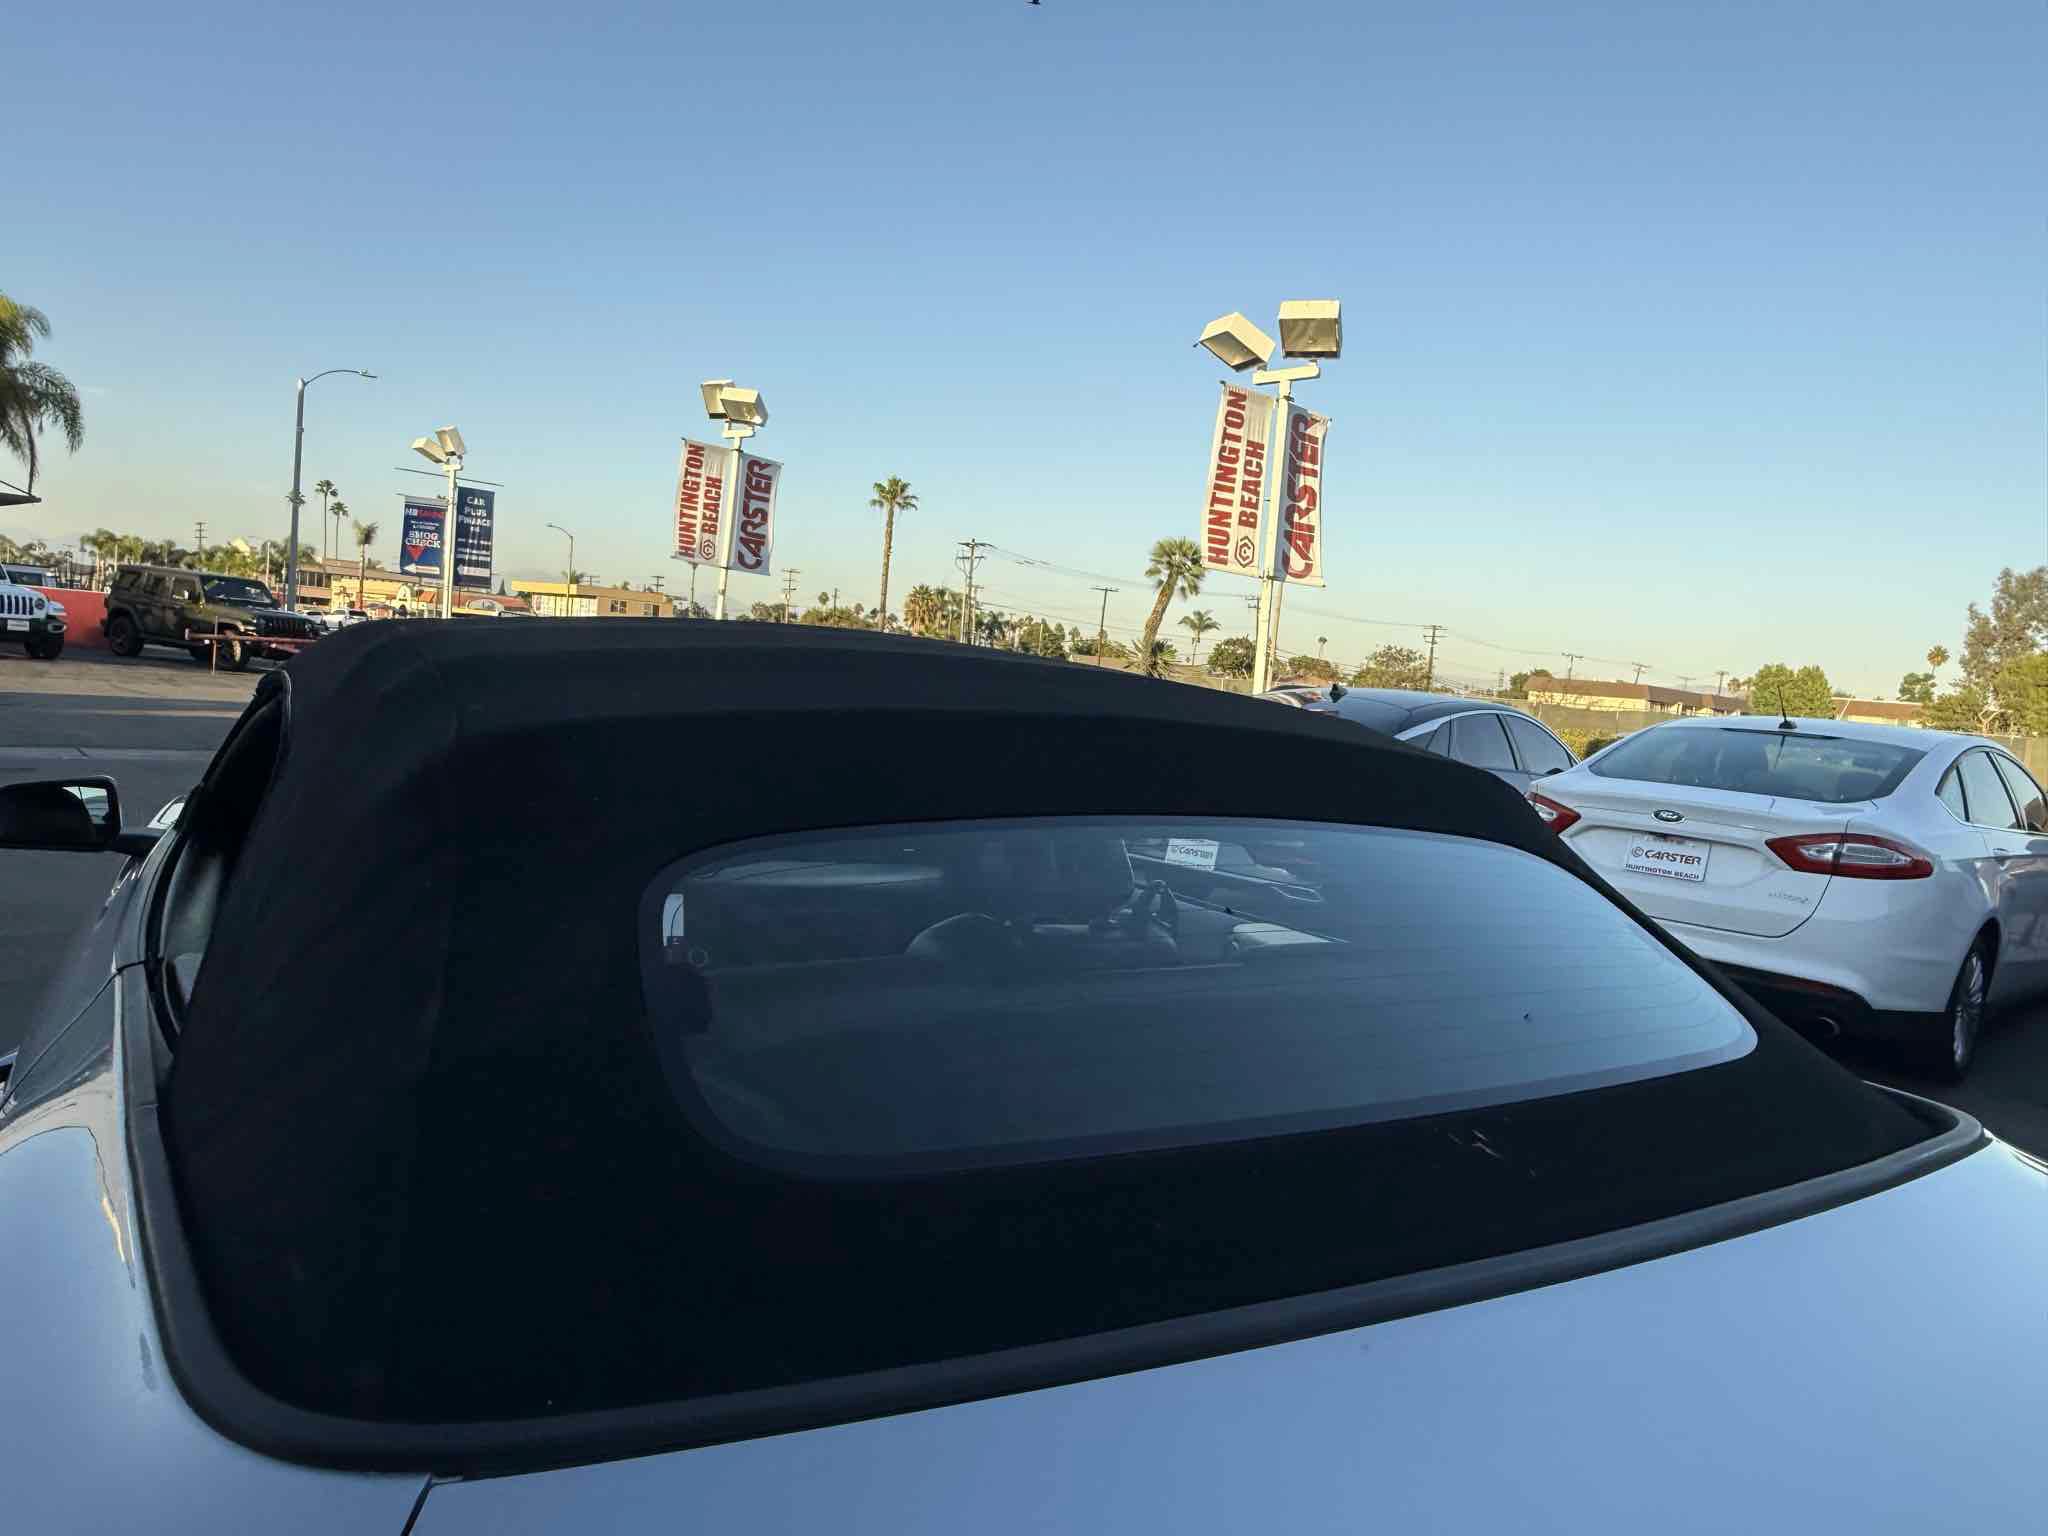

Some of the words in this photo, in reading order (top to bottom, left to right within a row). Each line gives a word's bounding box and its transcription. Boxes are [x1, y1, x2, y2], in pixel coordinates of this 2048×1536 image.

[678, 443, 705, 559] HUNTINGTON
[701, 475, 723, 535] BEACH
[737, 459, 773, 570] CARSTER
[1207, 389, 1249, 566] HUNTINGTON
[1238, 439, 1265, 530] BEACH
[1281, 413, 1321, 579] CARSTER
[405, 537, 441, 549] CHECK
[408, 530, 439, 540] SMOG
[1625, 863, 1673, 877] HUNTINGTON
[1673, 870, 1700, 880] BEACH
[1644, 849, 1702, 865] CARSTER
